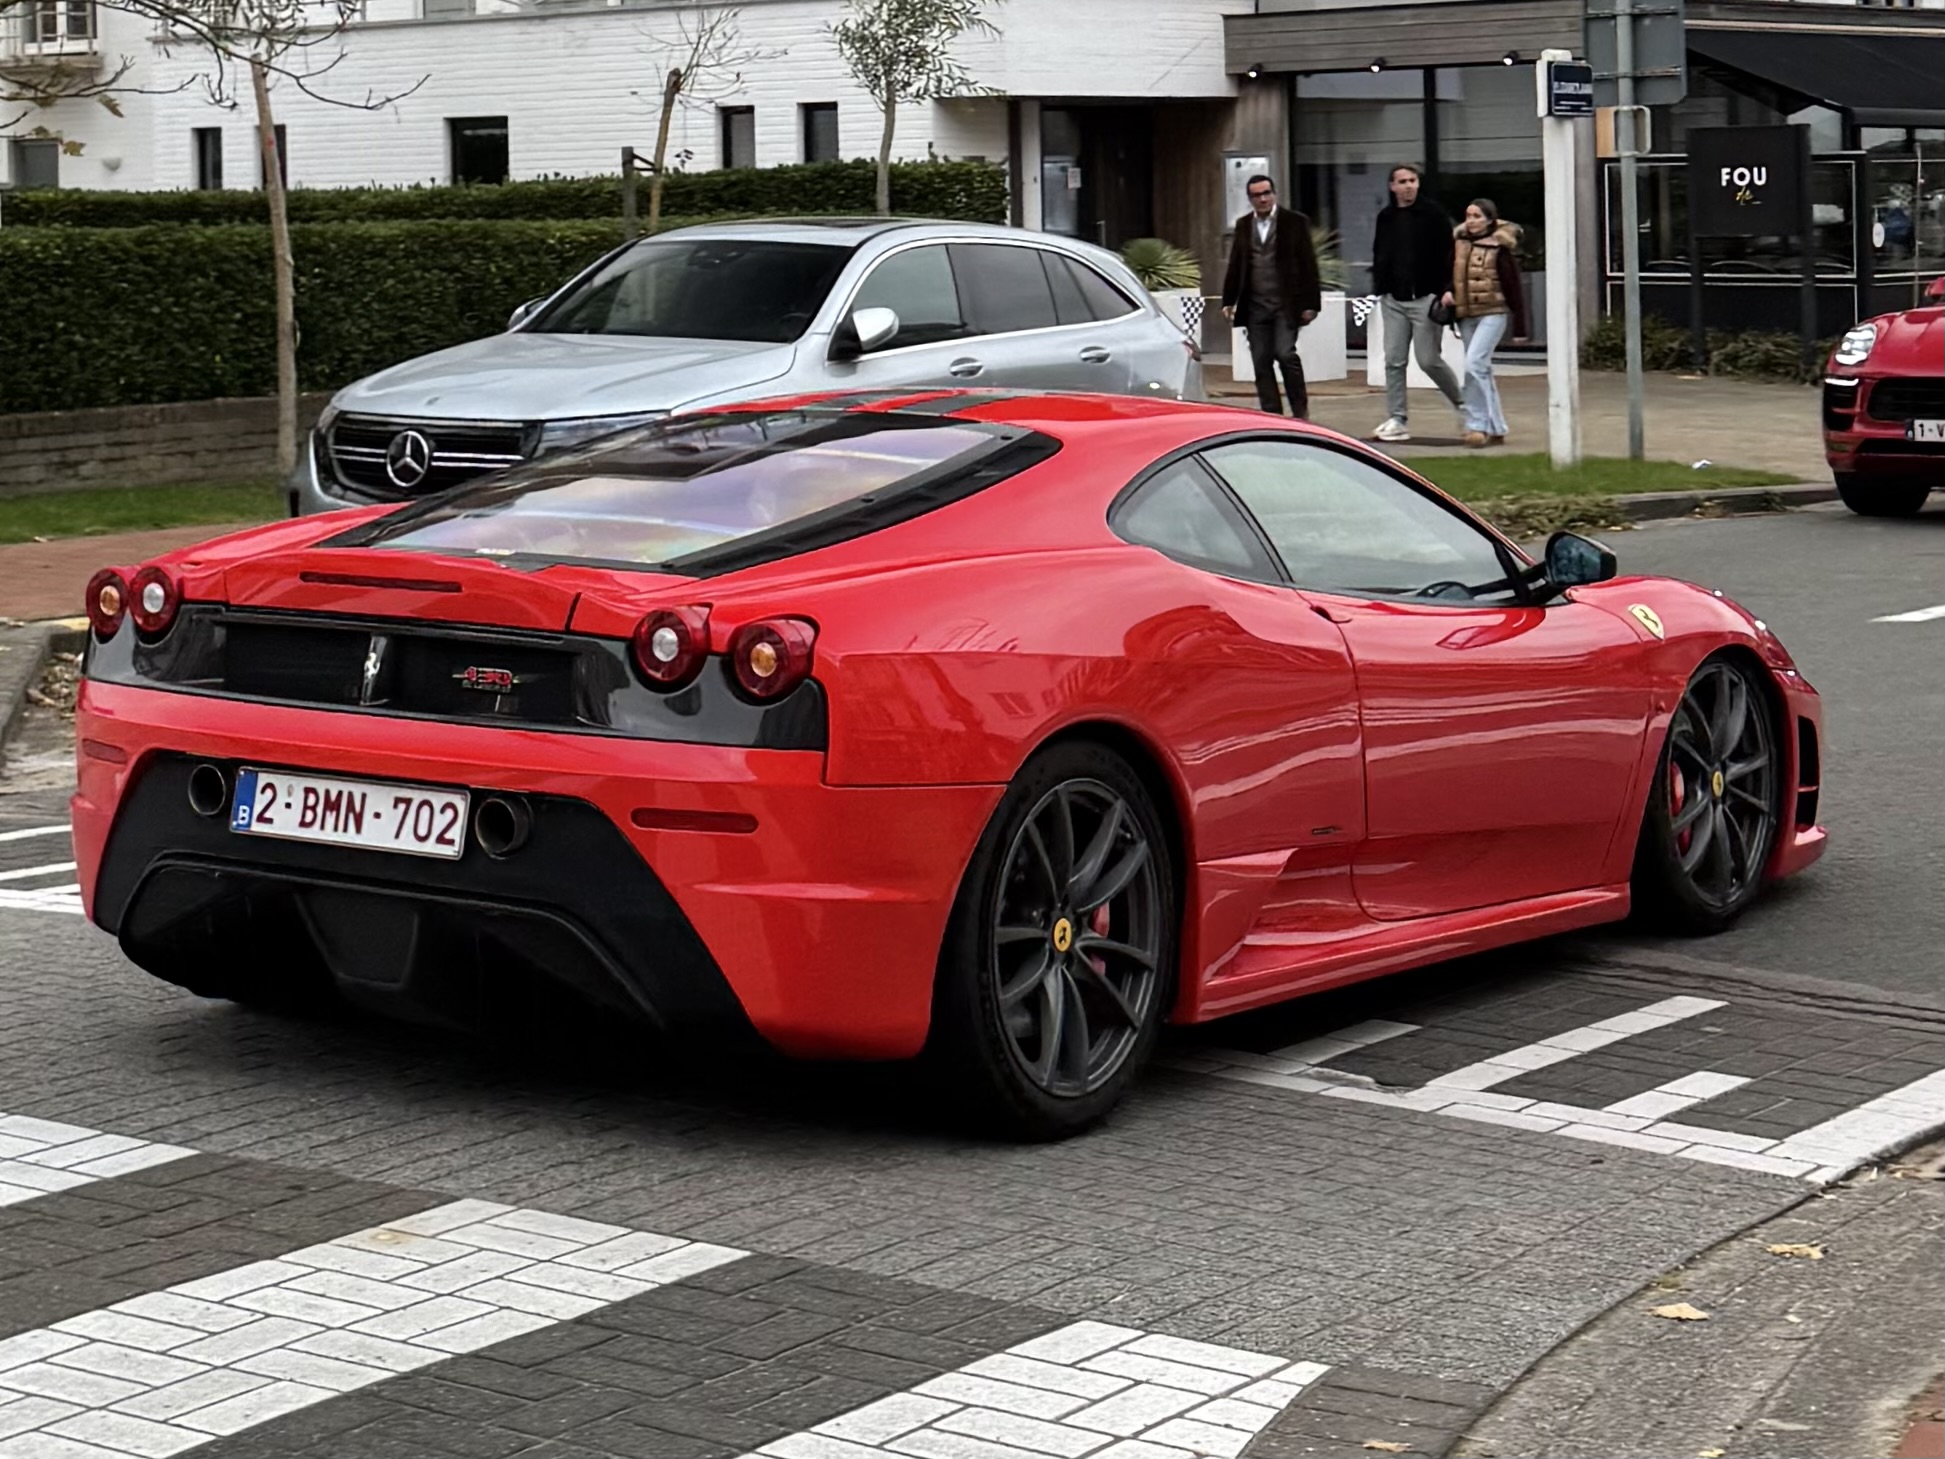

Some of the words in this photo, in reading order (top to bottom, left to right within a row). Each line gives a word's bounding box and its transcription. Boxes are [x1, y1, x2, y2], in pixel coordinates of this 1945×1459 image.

[1721, 166, 1767, 186] FOU
[238, 805, 250, 825] B
[255, 782, 460, 846] 2-BMN-702
